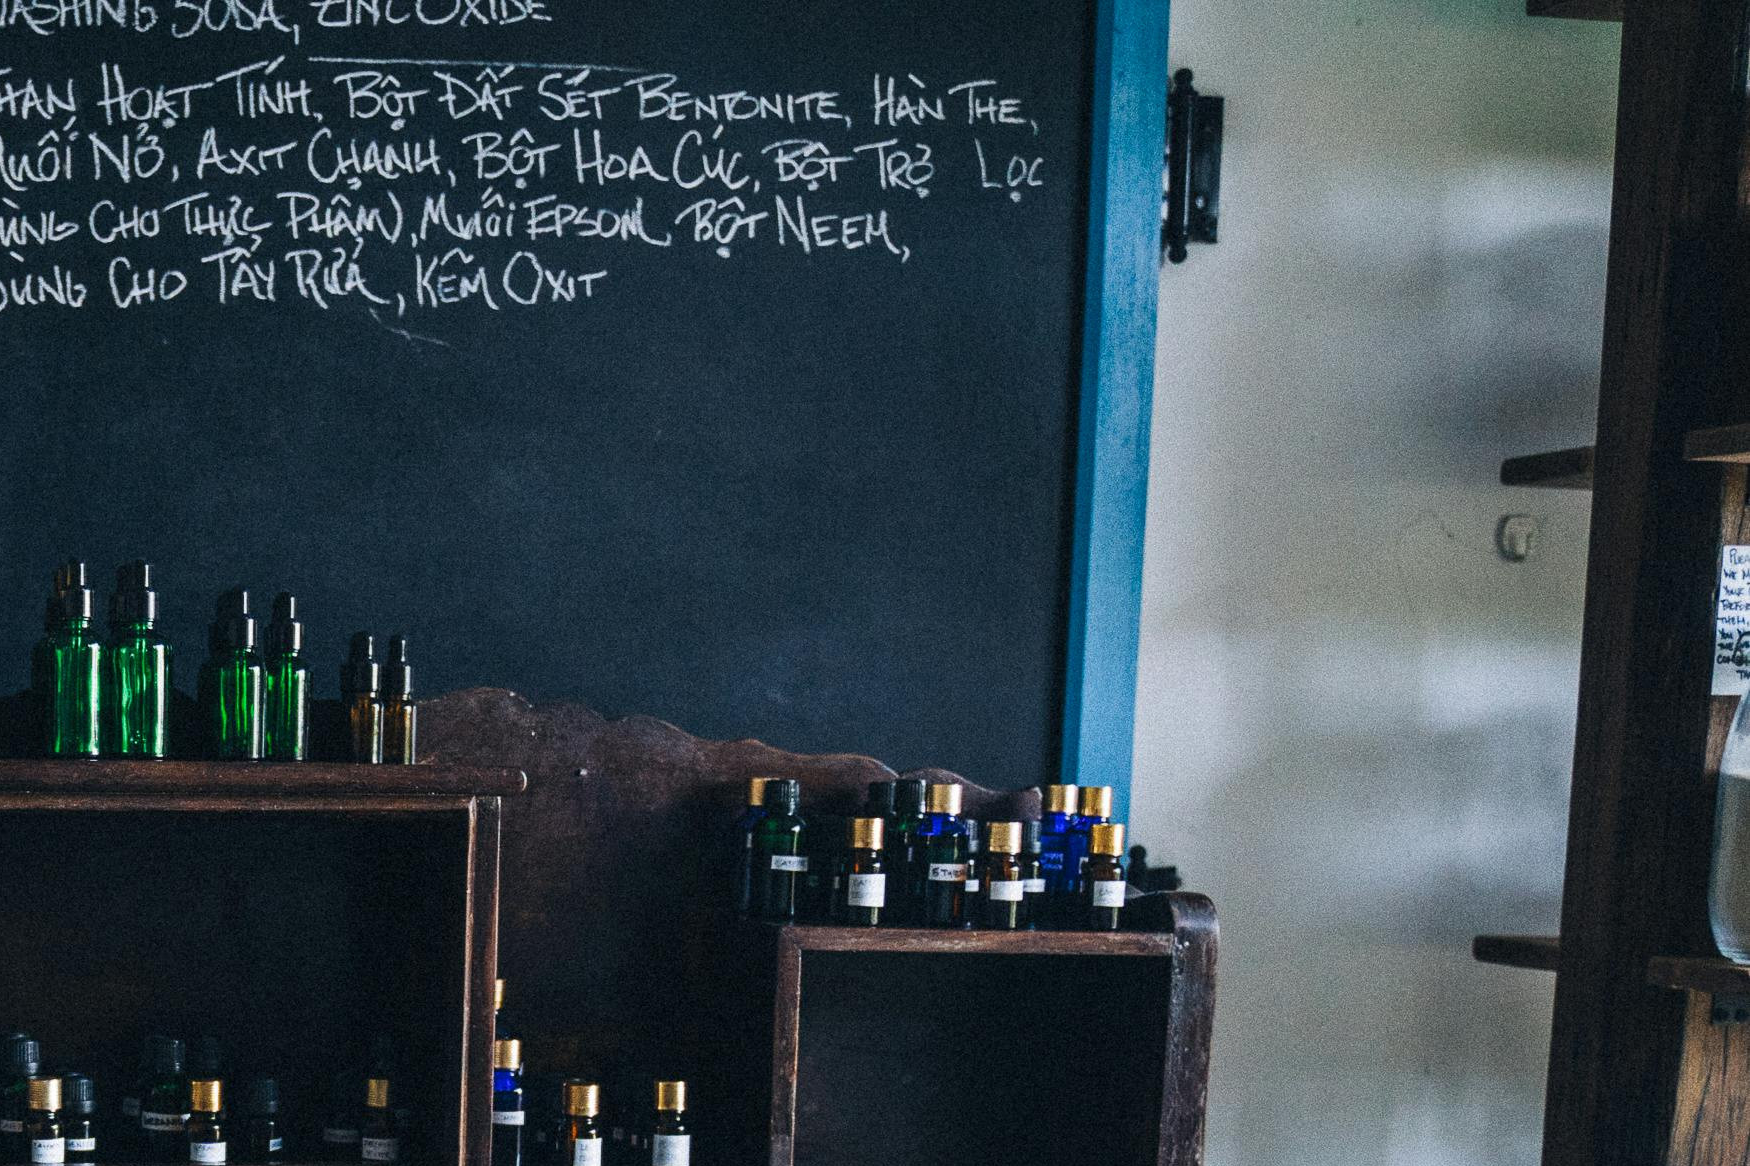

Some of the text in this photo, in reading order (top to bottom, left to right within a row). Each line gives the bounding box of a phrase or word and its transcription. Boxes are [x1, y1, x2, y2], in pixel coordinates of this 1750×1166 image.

[96, 62, 214, 129] HOẠT
[215, 55, 324, 122] TÍNH,
[334, 71, 429, 131] BỘT
[432, 65, 524, 120] ĐẤT
[538, 70, 621, 121] SÉT
[624, 72, 853, 128] BENTONITE,
[874, 72, 945, 126] HÀN
[949, 80, 1040, 136] THE,
[196, 127, 298, 180] AXIT
[462, 128, 560, 189] BỘT
[574, 128, 670, 186] HOA
[761, 138, 854, 192] BỘT
[974, 138, 1045, 203] LỌC
[89, 200, 159, 243] CHO
[674, 197, 769, 259] BỘT
[776, 194, 911, 263] NEEM,
[108, 256, 187, 309] CHO
[201, 234, 275, 304] TẨY
[415, 247, 499, 311] KẼM
[503, 250, 607, 305] OXIT
